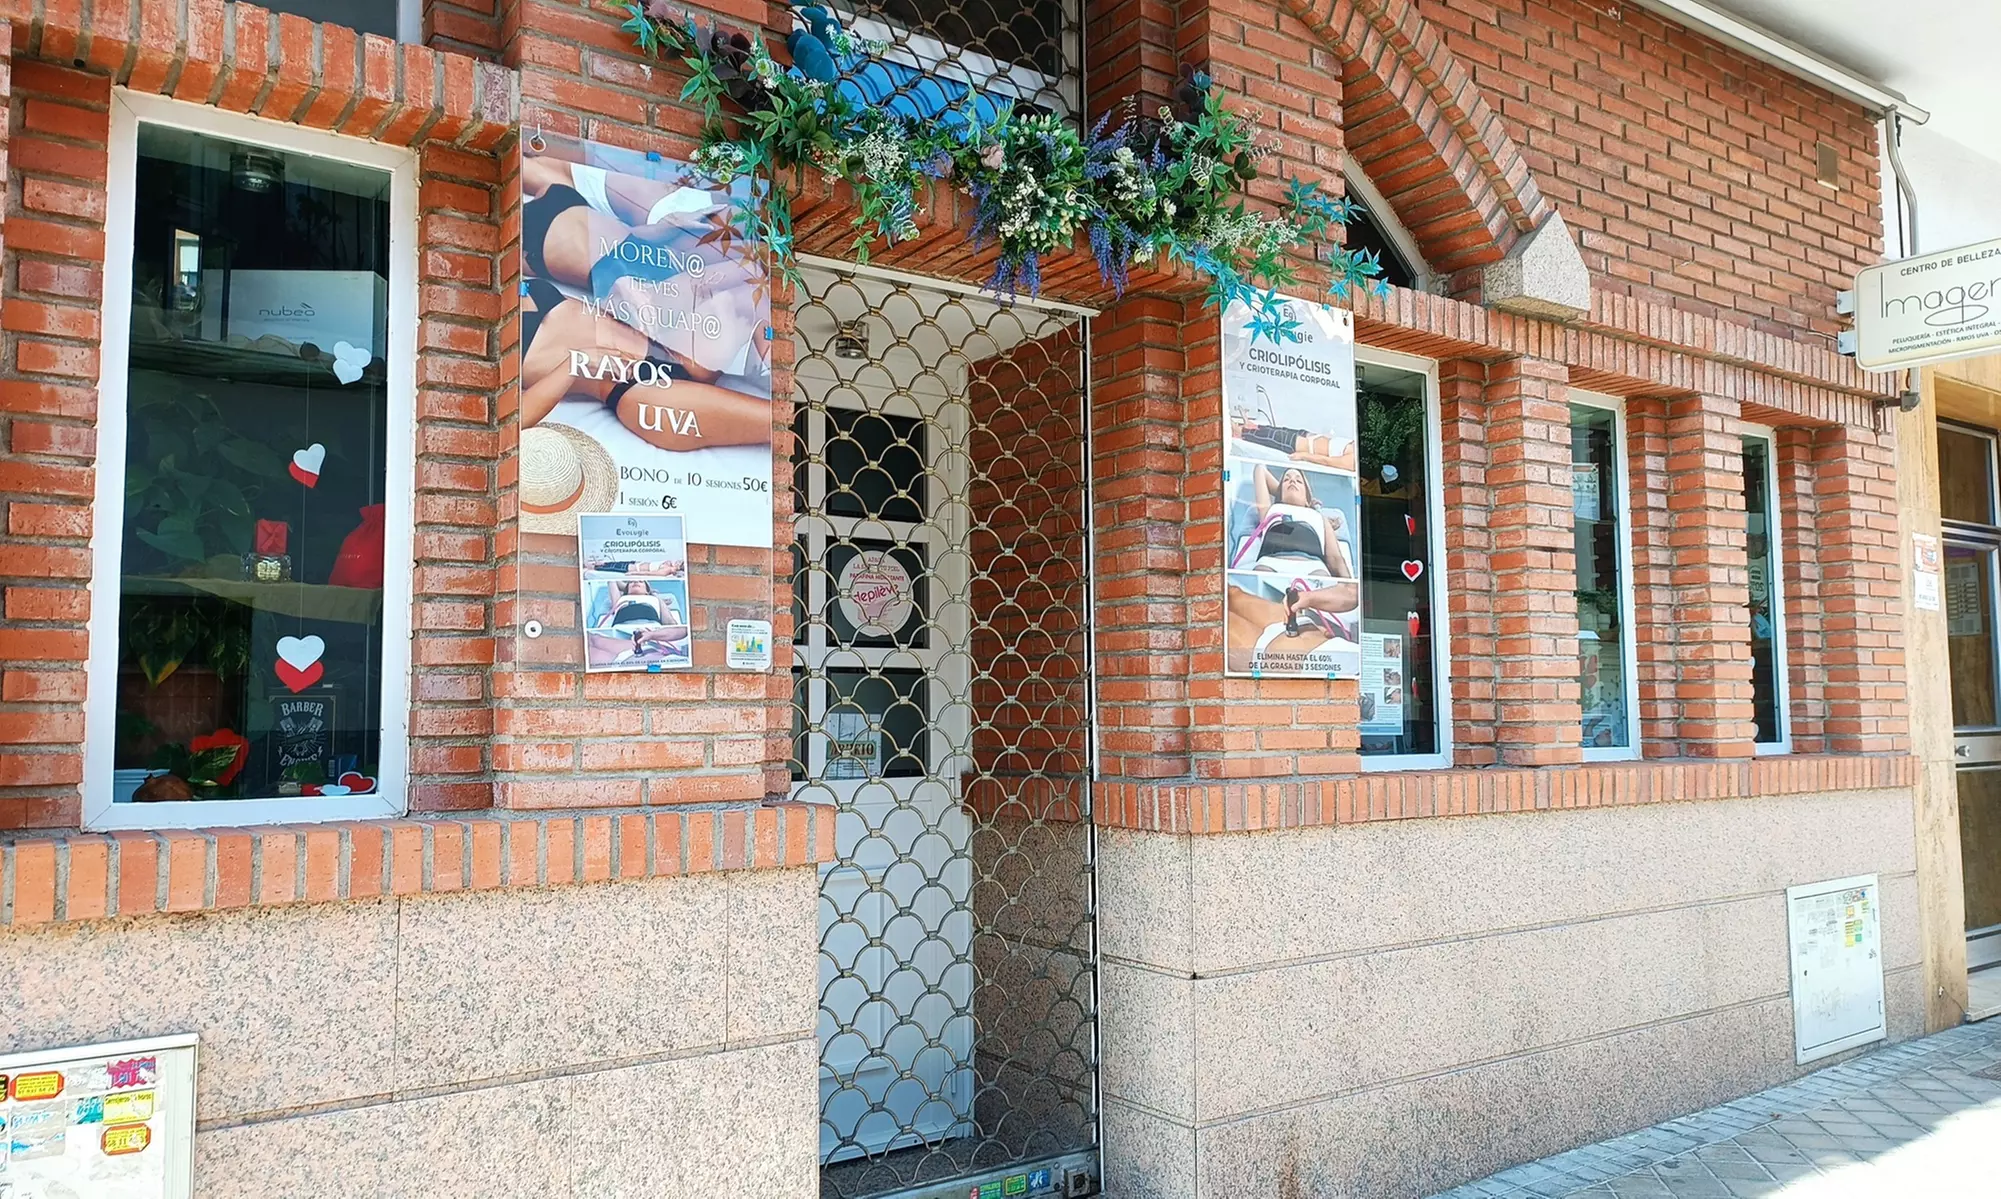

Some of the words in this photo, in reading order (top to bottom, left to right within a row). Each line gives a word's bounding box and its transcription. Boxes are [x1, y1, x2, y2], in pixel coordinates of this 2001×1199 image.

[599, 236, 705, 278] MOREN@
[1900, 261, 1938, 277] CENTRO
[1941, 258, 1953, 268] DE
[1957, 247, 2001, 264] BELLEZA
[630, 276, 646, 292] TE
[652, 280, 679, 297] VES
[580, 293, 630, 321] MÁS
[638, 304, 721, 339] GUAP@
[1888, 338, 1952, 354] MICROPIGMENTACIÓN
[1956, 334, 1975, 342] RAYOS
[1976, 331, 1989, 339] UVA
[1892, 332, 1930, 344] PELUQUERÍA
[1936, 326, 1964, 337] ESTÉTICA
[1965, 321, 1996, 331] INTEGRAL
[568, 349, 673, 389] RAYOS
[1249, 348, 1332, 375] CRIOLIPÓLISIS
[1239, 362, 1245, 370] Y
[1246, 363, 1299, 381] CRIOTERAPIA
[1300, 374, 1340, 389] CORPORAL
[637, 402, 703, 438] UVA
[620, 466, 669, 484] BONO
[687, 472, 702, 486] 10
[705, 480, 742, 491] SESIONES
[743, 477, 768, 492] 50€
[629, 497, 659, 507] SESIÓN
[662, 495, 677, 509] 6€
[604, 540, 661, 548] CRIOLIPÓLISIS
[1270, 662, 1293, 670] GRASA
[1286, 653, 1308, 661] HASTA
[281, 701, 324, 716] BARBER
